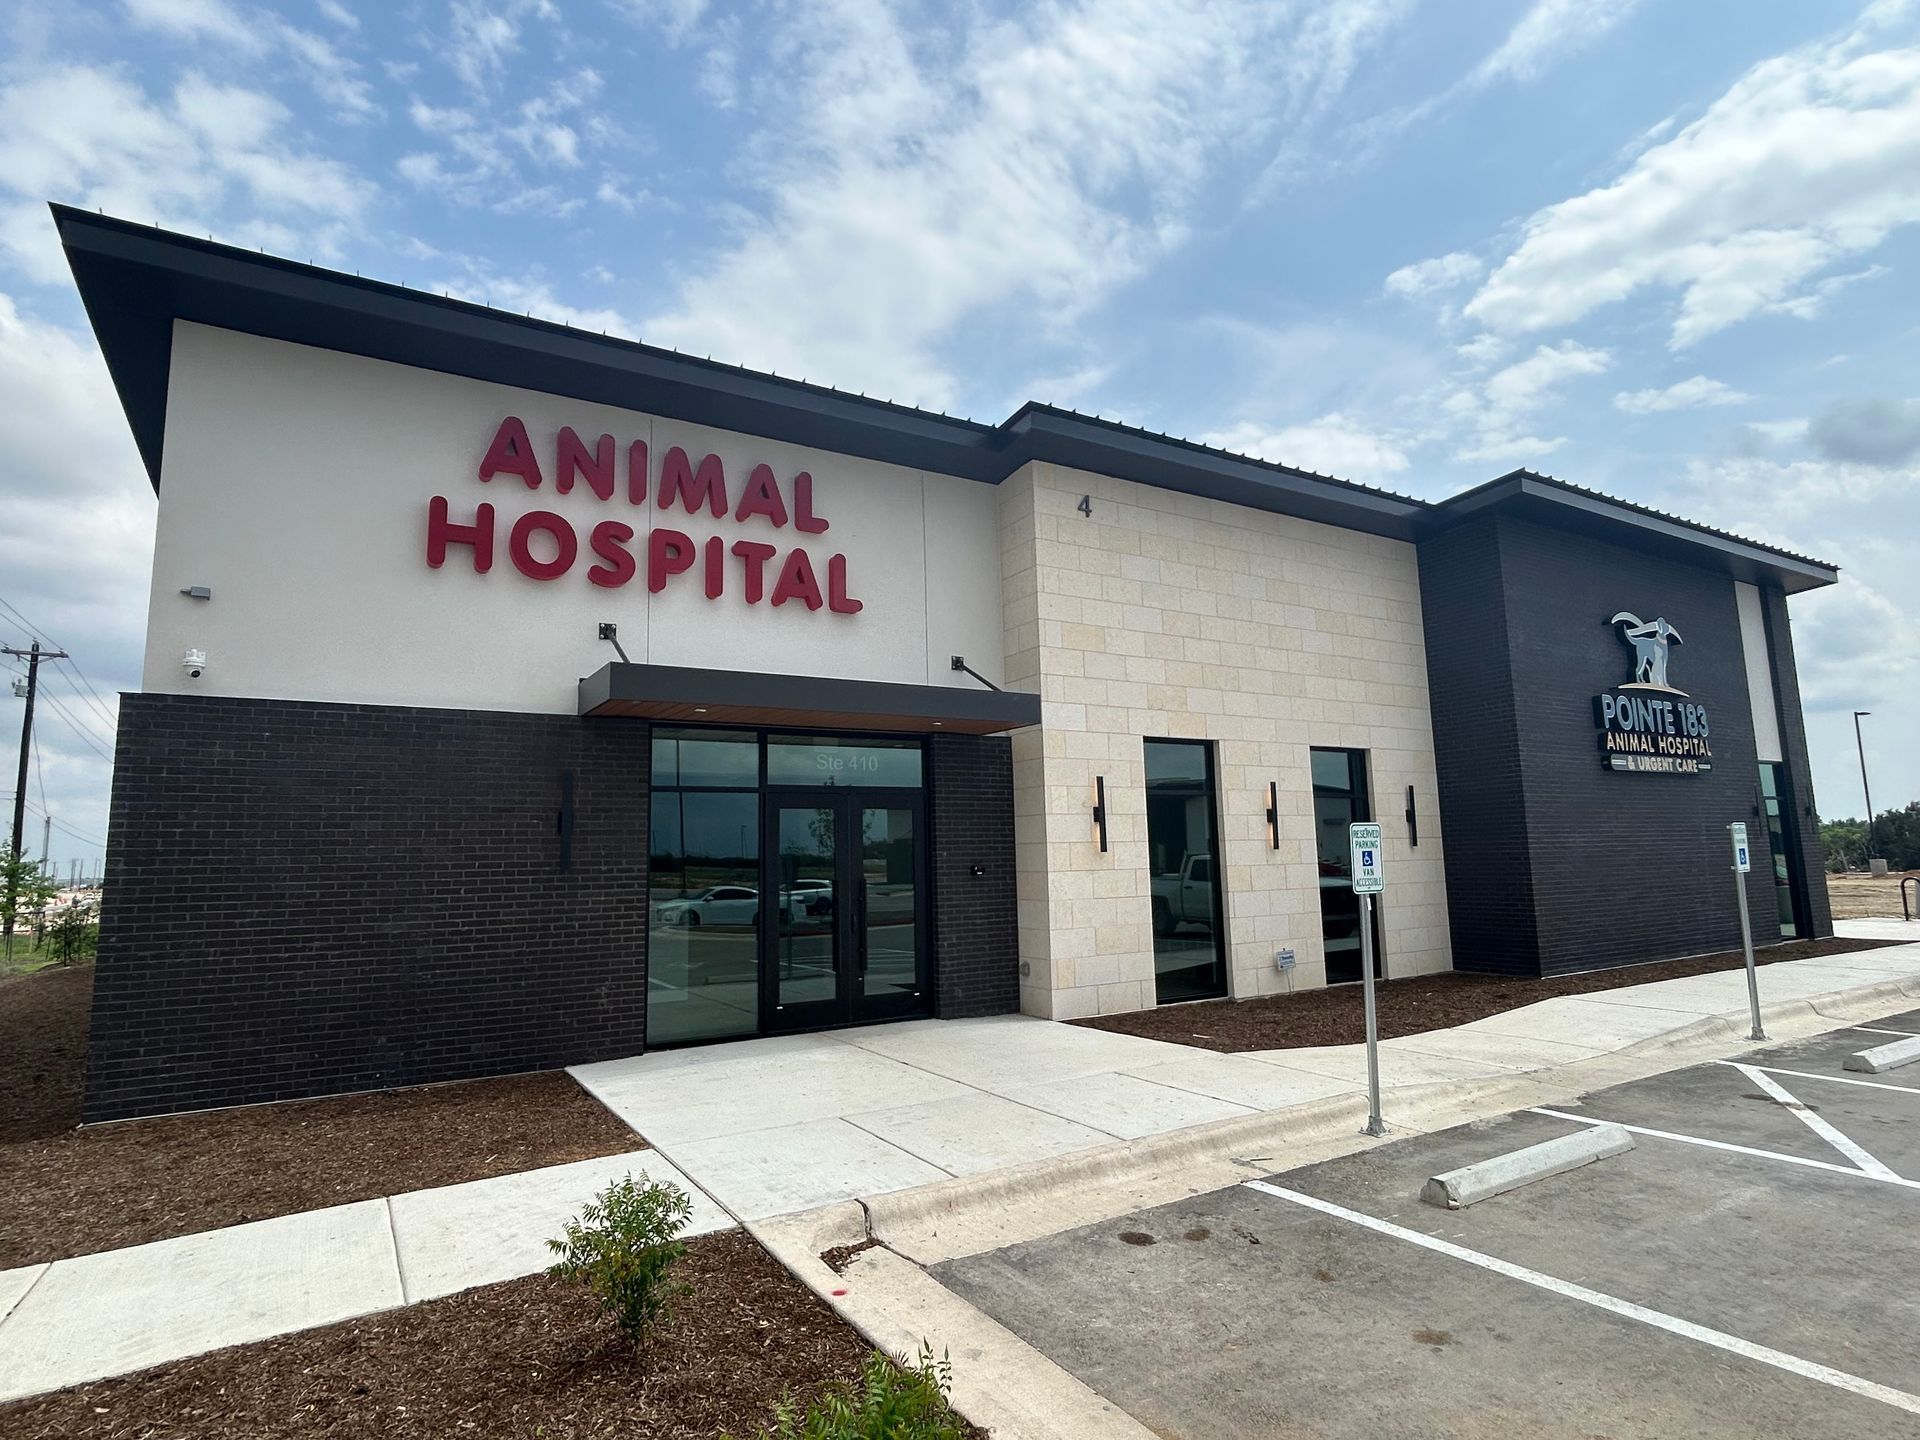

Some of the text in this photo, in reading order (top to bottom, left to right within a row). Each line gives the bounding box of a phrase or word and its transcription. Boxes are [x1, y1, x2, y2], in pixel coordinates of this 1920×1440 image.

[479, 416, 829, 534] ANIMAL
[1078, 495, 1092, 518] 4
[426, 495, 863, 613] HOSPITAL
[1601, 694, 1709, 737] POINTE 183
[1606, 731, 1712, 756] ANIMAL HOSPITAL
[816, 753, 878, 772] Ste 410
[1627, 755, 1698, 772] & URGENT CARE
[1353, 829, 1379, 838] RESERVED
[1355, 840, 1379, 849] PARKING
[1356, 877, 1382, 887] ACCESSIBLE
[1363, 868, 1375, 877] VAN
